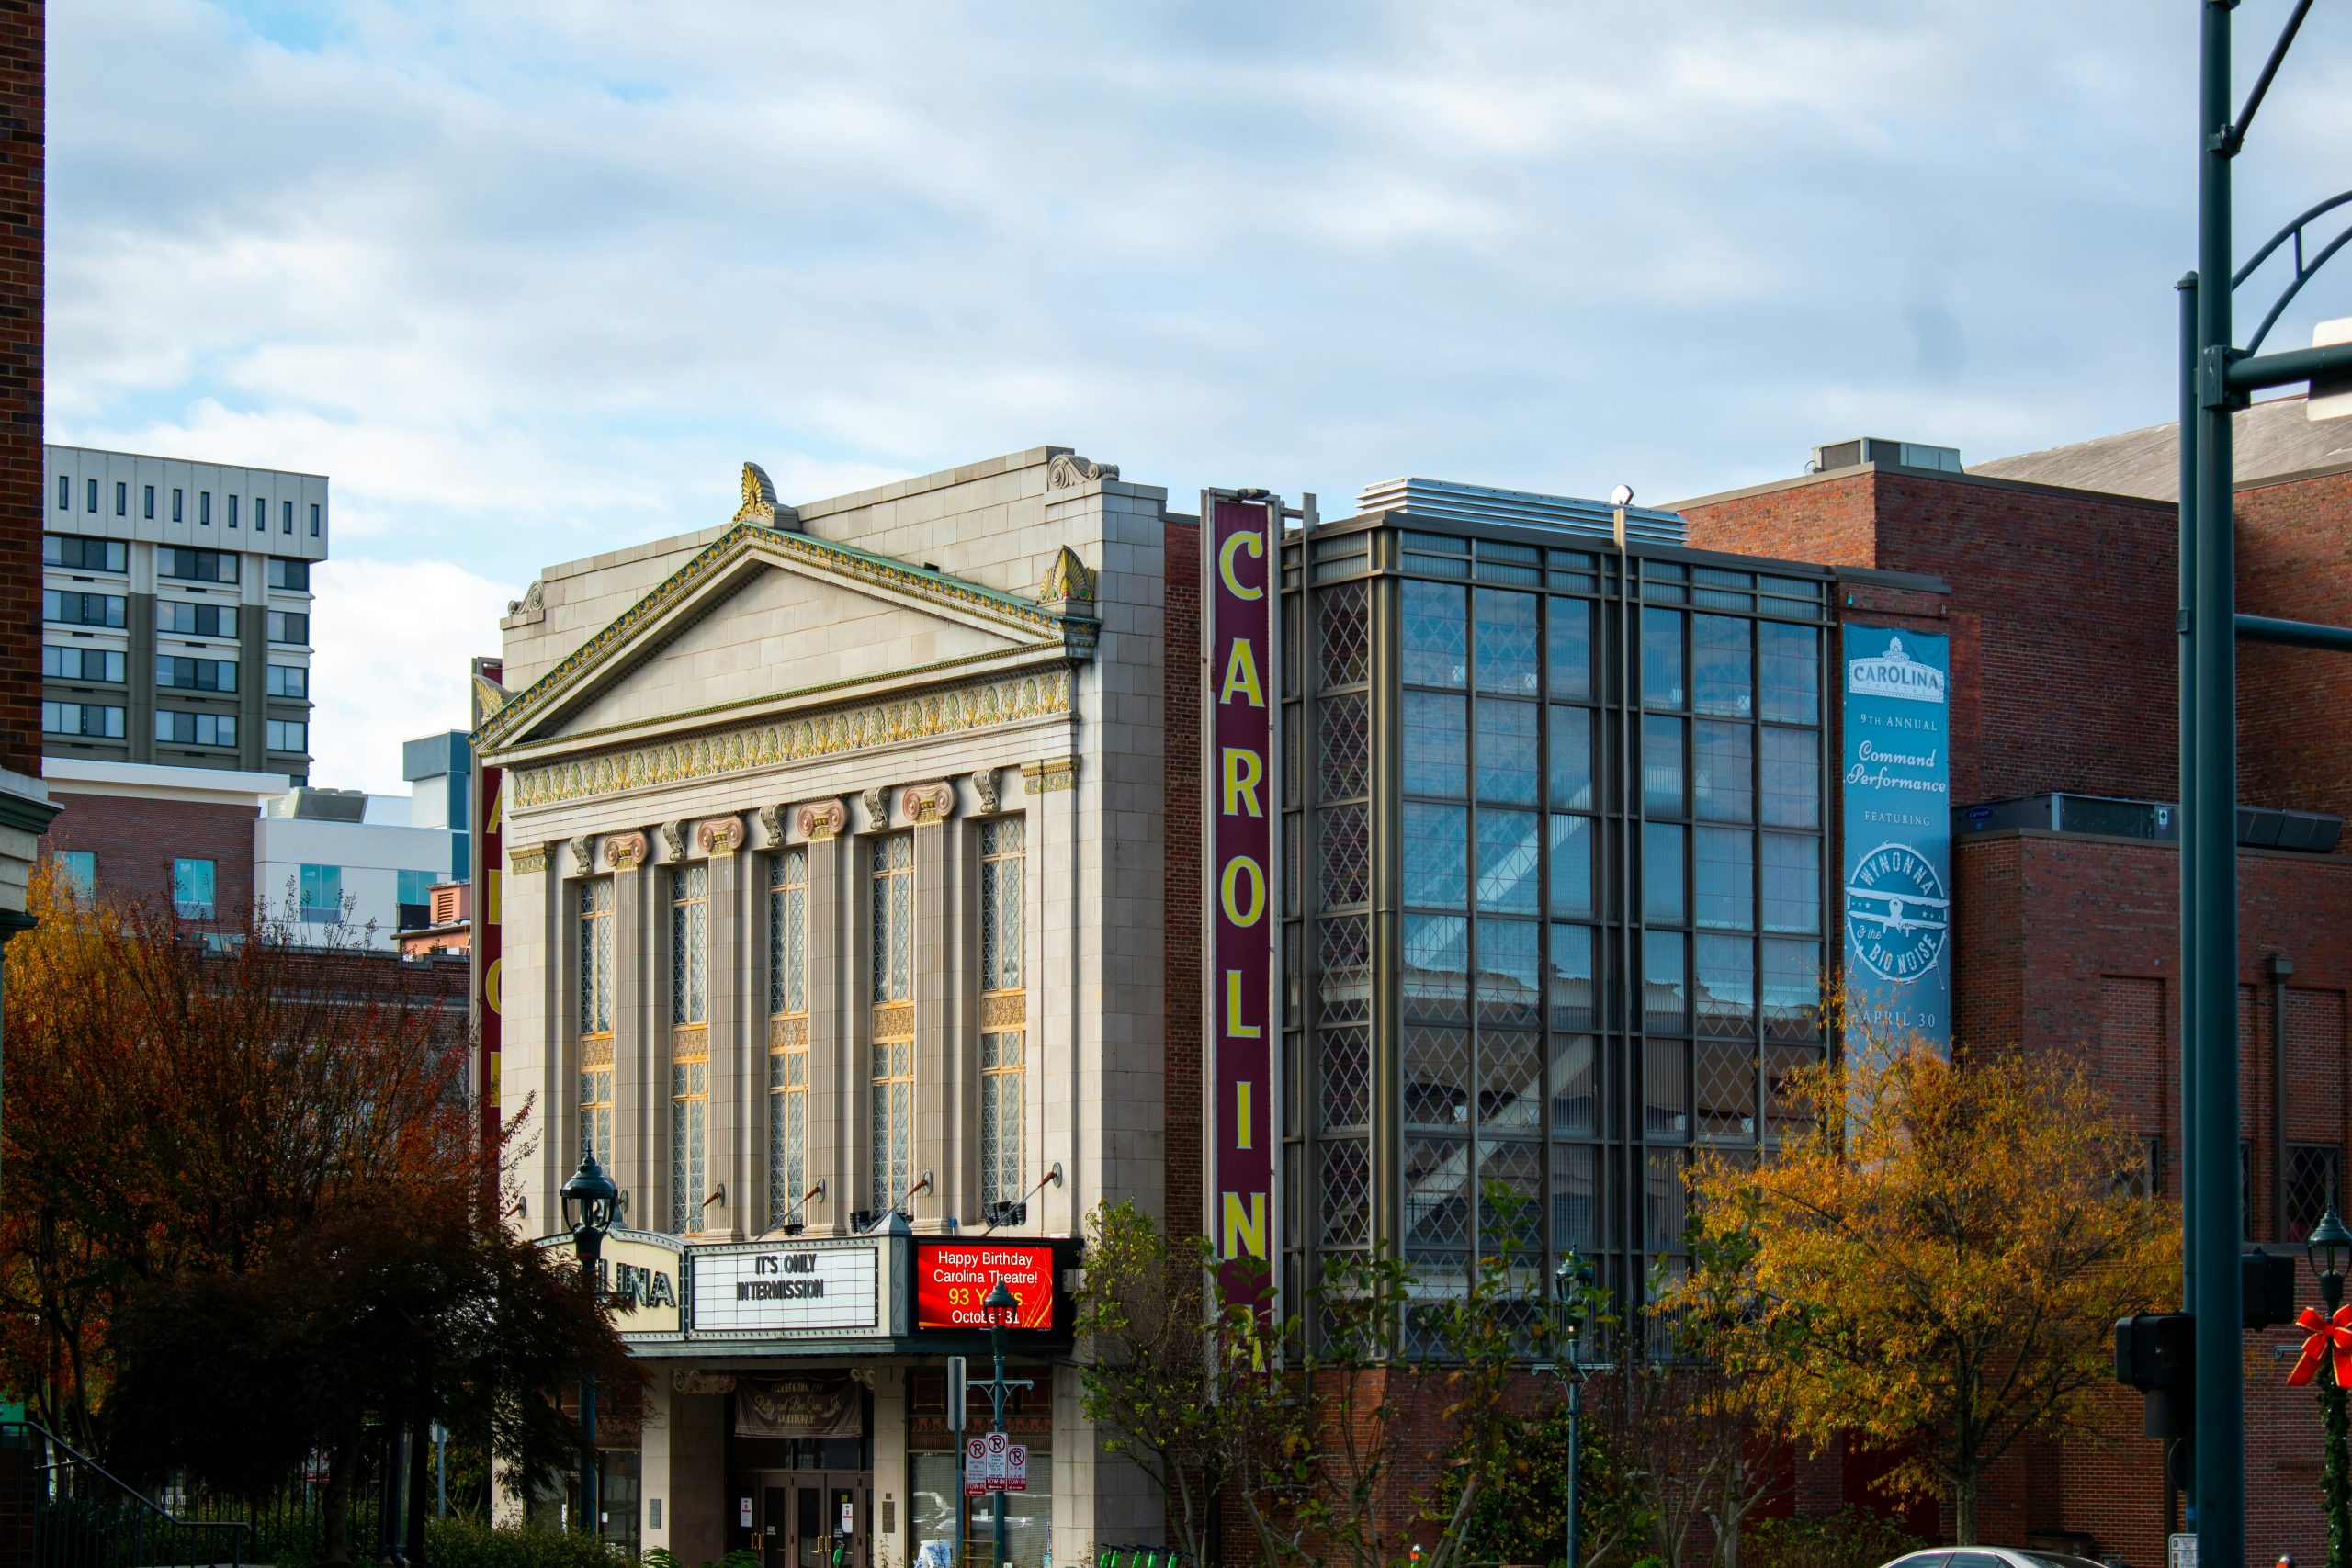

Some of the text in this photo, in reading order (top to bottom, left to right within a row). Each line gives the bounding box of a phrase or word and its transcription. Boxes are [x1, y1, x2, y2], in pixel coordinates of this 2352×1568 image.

[1854, 666, 1939, 690] CAROLINA
[1860, 714, 1938, 731] 9TH ANNUAL
[1859, 739, 1937, 768] Command
[1846, 763, 1946, 793] Performance
[1864, 810, 1930, 827] FEATURING
[1859, 851, 1935, 897] WYNONNA
[1857, 925, 1882, 940] & the
[1218, 530, 1267, 1373] CAROLINA
[1897, 933, 1936, 974] NOISE
[1863, 1010, 1935, 1029] APRIL 30
[755, 1254, 817, 1275] IT'S ONLY
[938, 1250, 1033, 1269] Happy Birthday
[933, 1269, 1038, 1284] Carolina Theatre!
[737, 1279, 824, 1301] INTERMISSION
[949, 1288, 969, 1305] 93
[1005, 1310, 1021, 1324] 31
